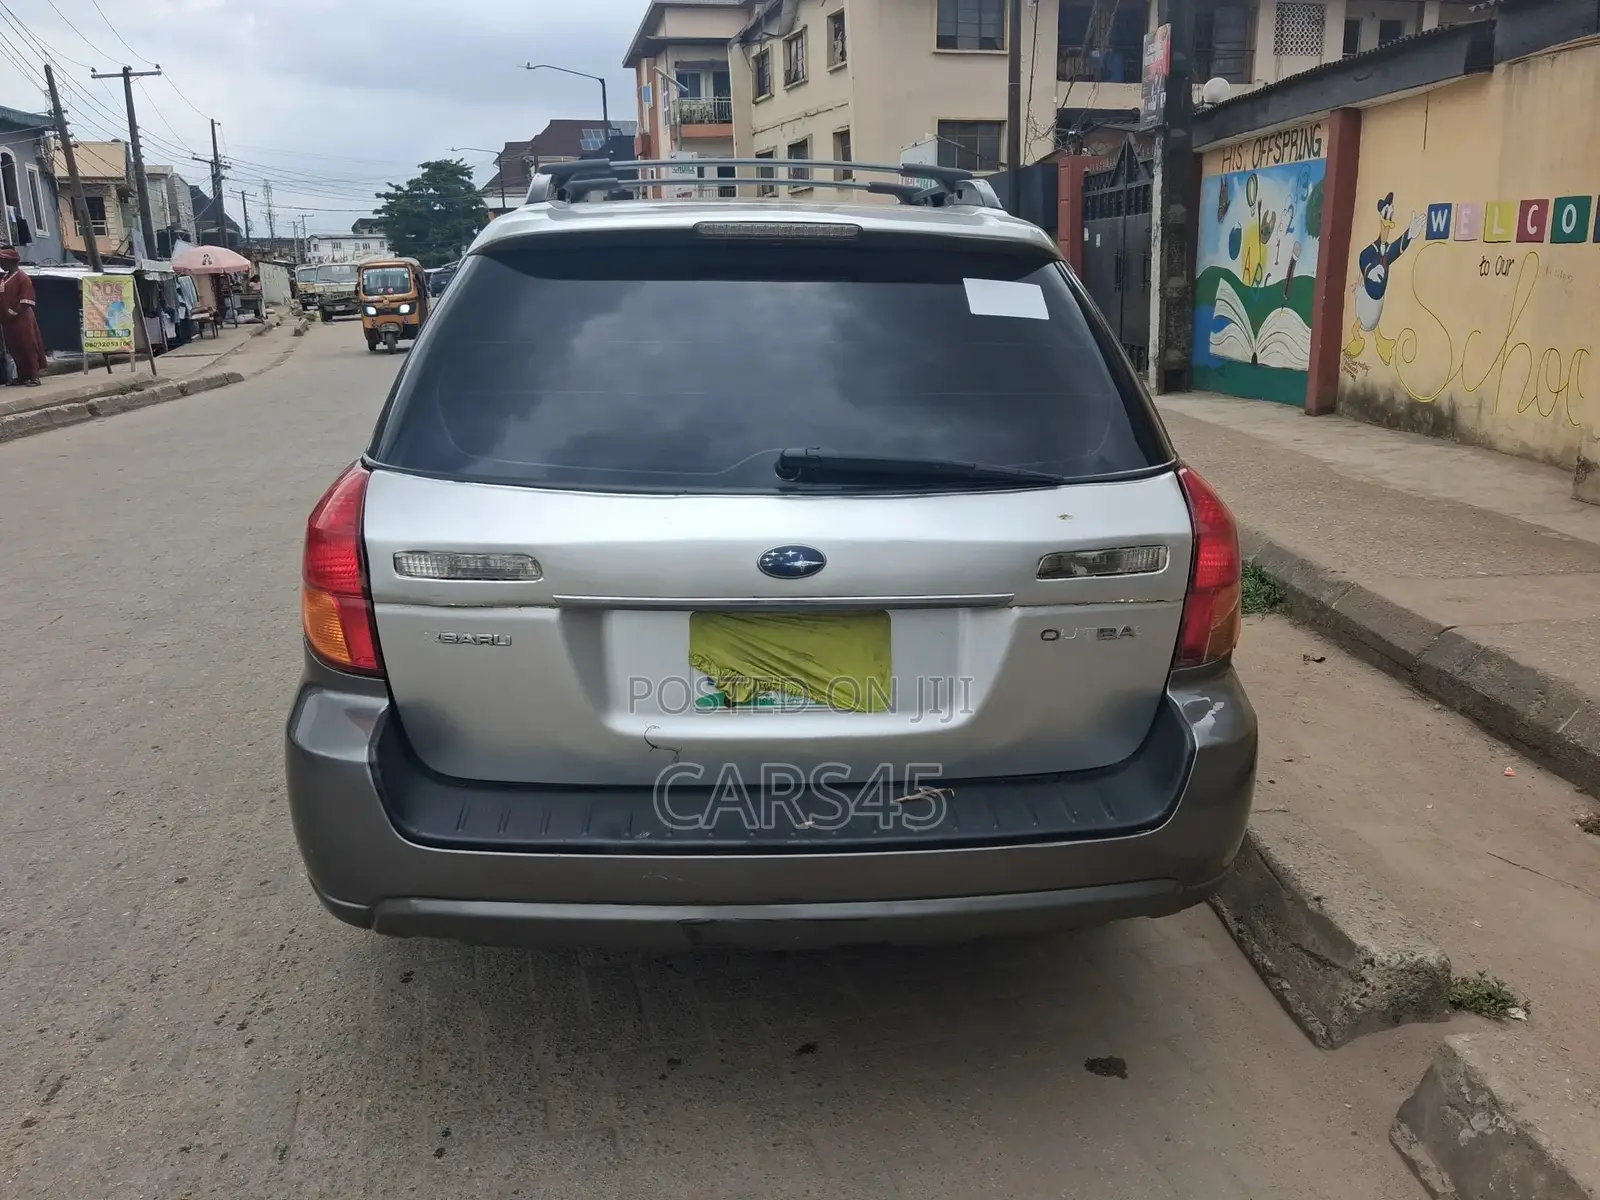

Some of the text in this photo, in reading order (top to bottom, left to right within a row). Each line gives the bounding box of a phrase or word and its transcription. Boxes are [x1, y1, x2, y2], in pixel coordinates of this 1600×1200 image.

[1252, 123, 1322, 169] OFFSPRING
[1431, 203, 1578, 237] WELCO
[1479, 255, 1490, 277] to
[88, 283, 123, 297] POS
